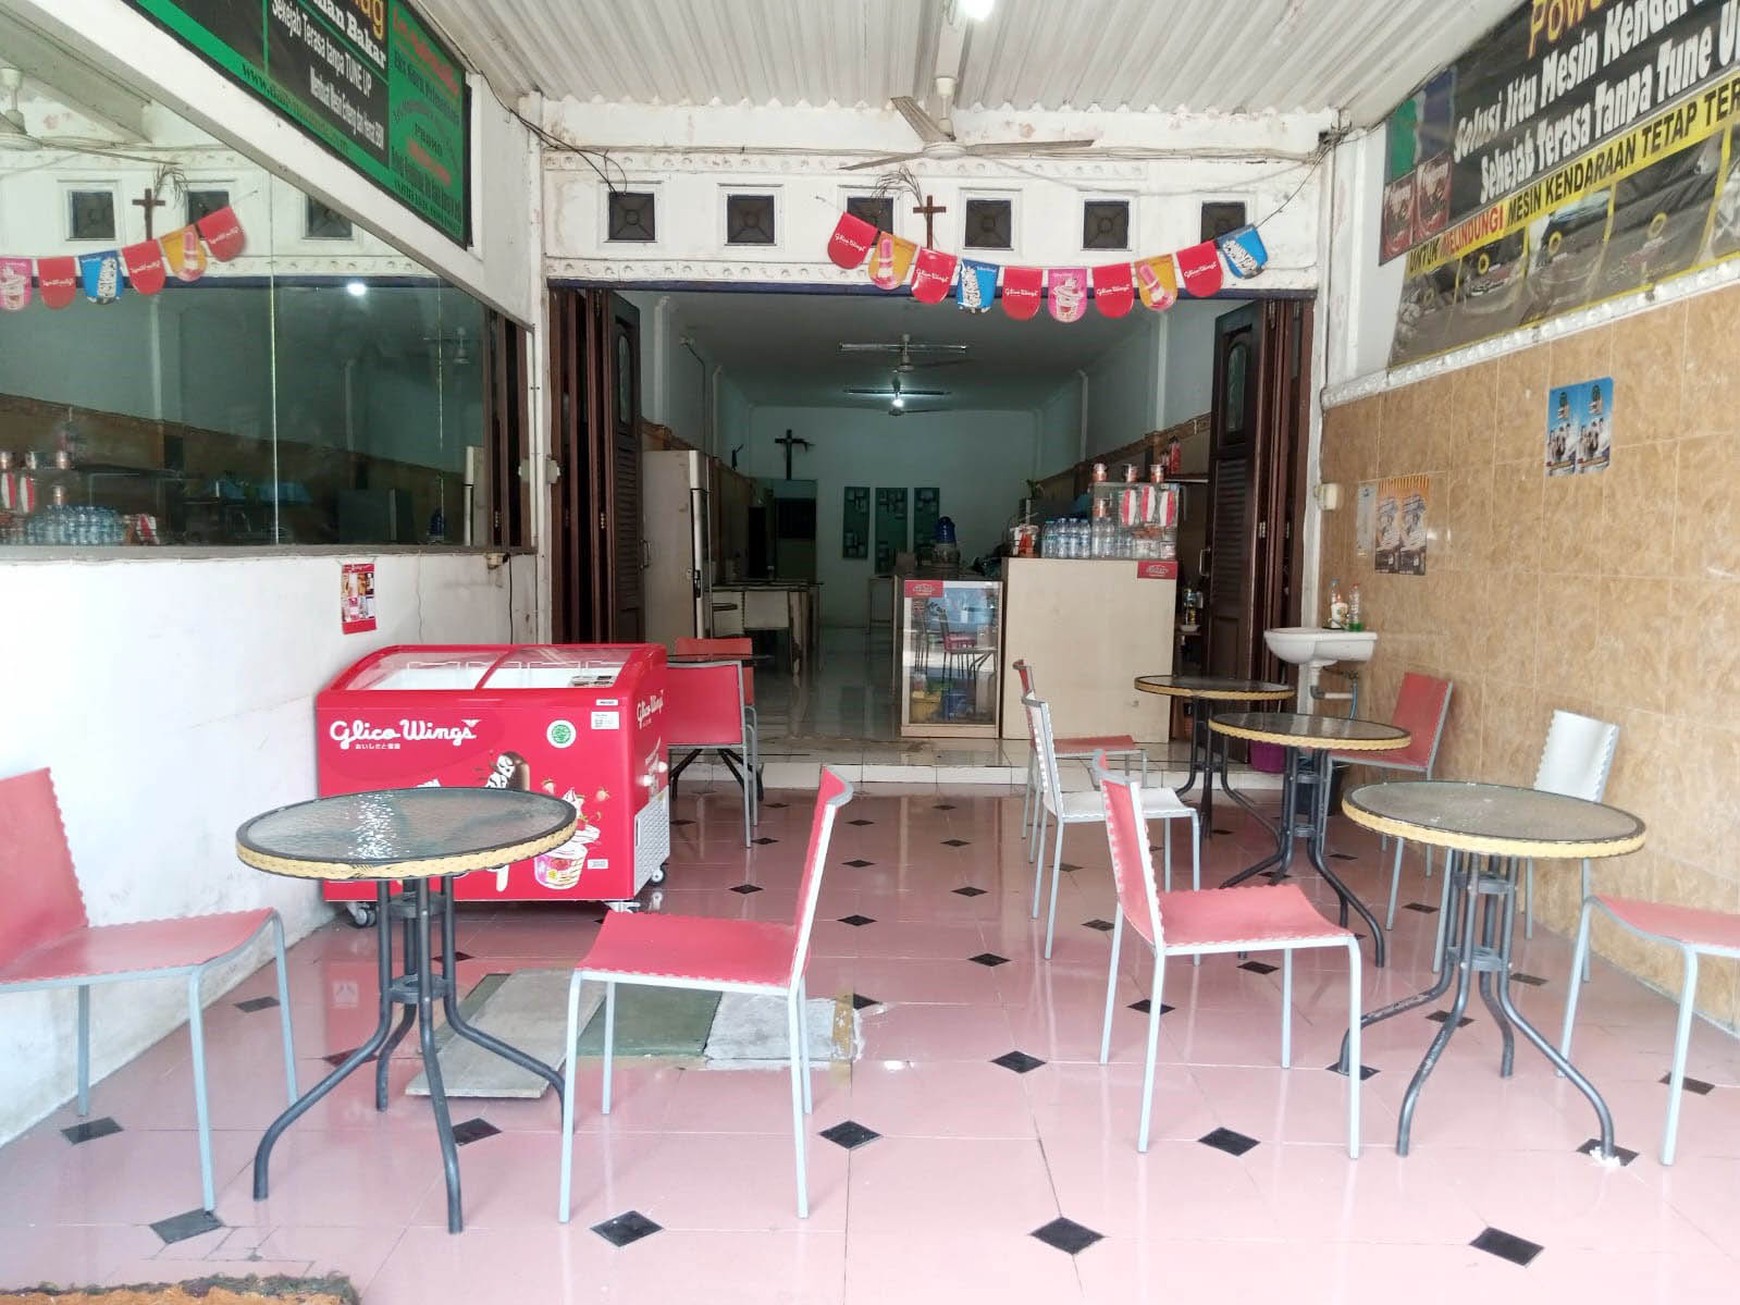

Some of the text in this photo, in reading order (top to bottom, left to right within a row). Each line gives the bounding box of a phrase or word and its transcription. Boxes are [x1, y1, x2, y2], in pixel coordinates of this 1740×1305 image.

[302, 13, 325, 59] Terasa
[346, 10, 387, 70] Bakar
[1454, 90, 1502, 164] Solusi
[1504, 73, 1537, 131] Jitu
[1540, 28, 1598, 109] Mesin
[1480, 129, 1535, 204] Sekejab
[1536, 102, 1591, 172] Terasa
[1594, 64, 1653, 140] Tanpa
[1657, 26, 1712, 103] Tune
[1719, 0, 1740, 66] U
[1409, 237, 1440, 273] UNTUK
[1439, 205, 1504, 259] MELINDUNGI
[1508, 185, 1542, 226] MESIN
[1546, 133, 1636, 204] KENDARAAN
[1641, 101, 1697, 158] TETAP
[329, 718, 478, 750] Glico Wings
